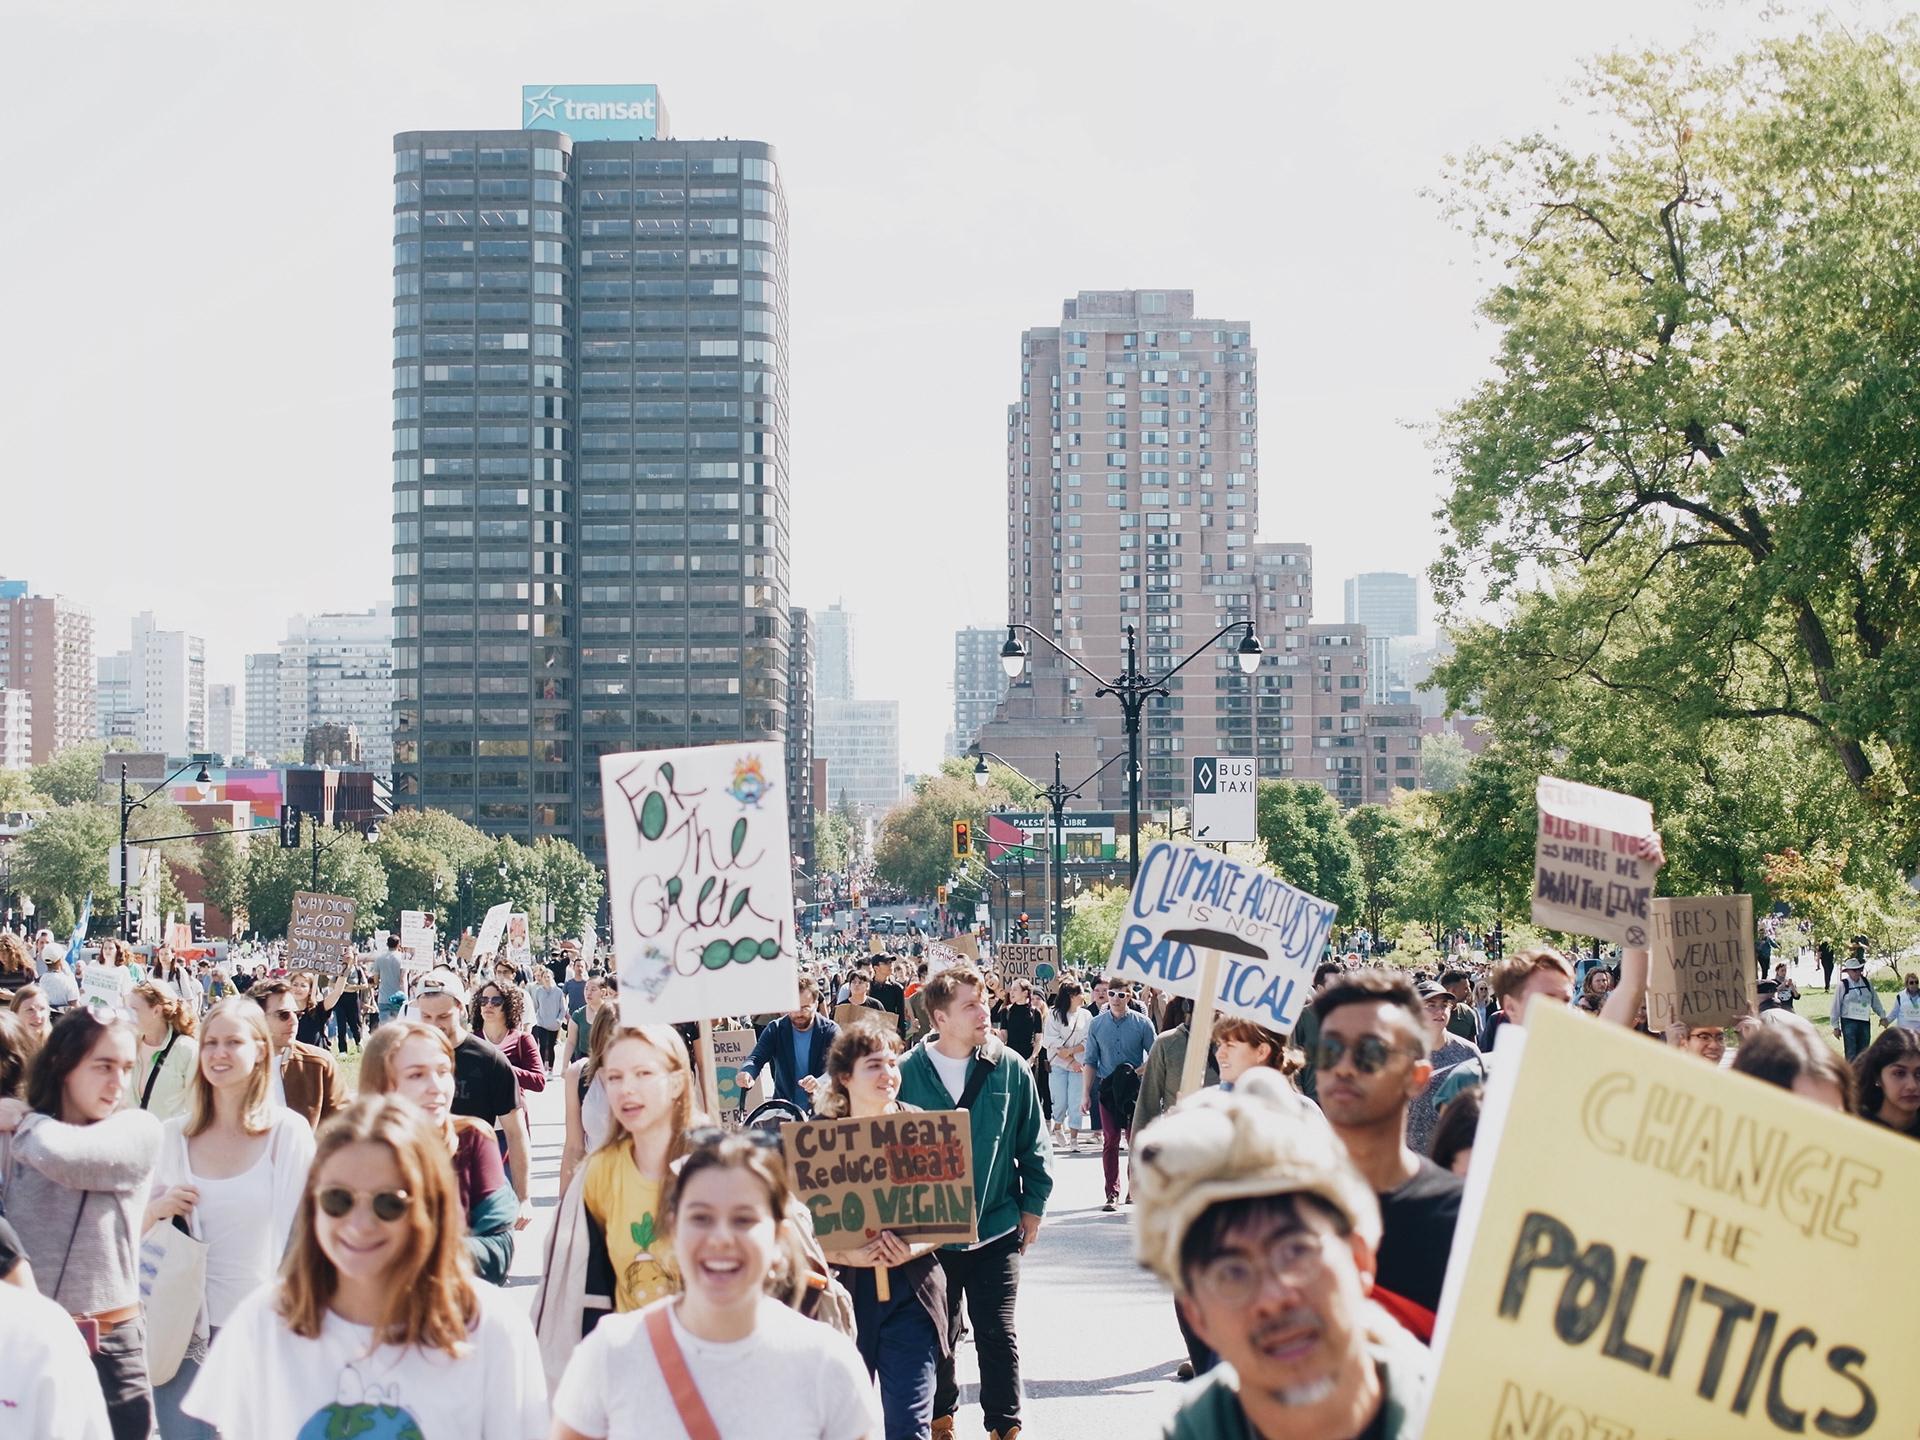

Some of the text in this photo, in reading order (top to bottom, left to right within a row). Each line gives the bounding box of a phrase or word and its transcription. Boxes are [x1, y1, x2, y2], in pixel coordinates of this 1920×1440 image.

[565, 99, 655, 120] transat
[1219, 764, 1252, 776] BUS
[1219, 781, 1252, 793] TAXI
[1013, 818, 1087, 827] PALESTNE LIBRE
[1563, 846, 1607, 872] WHERE
[1616, 858, 1640, 880] WE
[298, 896, 325, 912] WHY
[1133, 842, 1335, 972] CLIMATE ACTIVISM
[1538, 867, 1651, 920] DRAW THE LINE
[296, 910, 314, 926] WE
[1188, 905, 1273, 943] IS NOT
[1651, 907, 1743, 940] THERE'S N
[293, 938, 317, 951] YOU
[1000, 946, 1053, 962] RESPECT
[1000, 961, 1029, 975] YOUR
[1695, 969, 1720, 983] ON
[714, 1042, 741, 1054] DREN
[795, 1115, 961, 1158] CUT Meat
[795, 1154, 887, 1191] Reduce
[1582, 1071, 1884, 1249] CHANGE
[806, 1183, 973, 1236] GO VEGAN
[1674, 1201, 1764, 1269] THE
[1498, 1210, 1879, 1439] POLITICS
